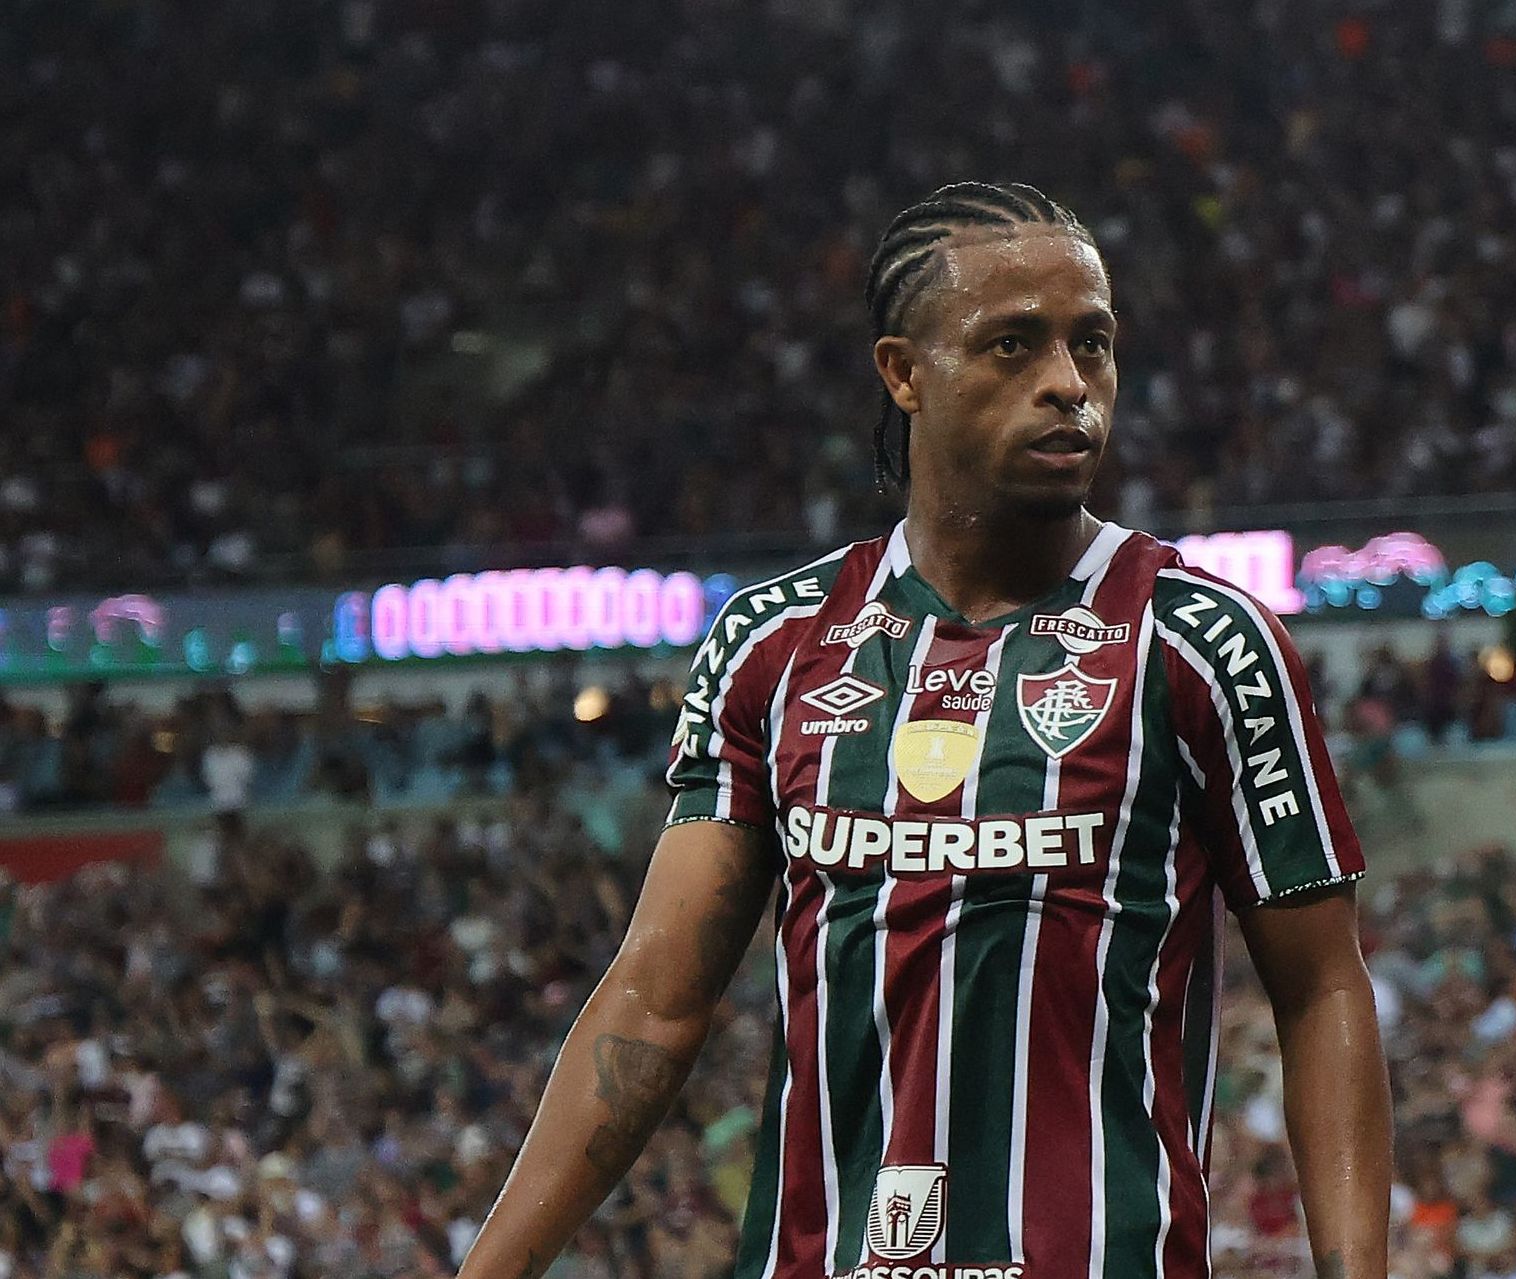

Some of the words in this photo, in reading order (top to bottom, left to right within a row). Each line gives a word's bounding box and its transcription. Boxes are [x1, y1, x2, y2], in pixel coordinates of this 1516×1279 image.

[832, 615, 902, 641] FRESCATTO
[1037, 619, 1124, 641] FRESCATTO
[906, 665, 996, 694] Leve
[942, 692, 991, 711] saúde
[1172, 592, 1300, 826] ZINZANE
[800, 716, 869, 736] umbro
[786, 806, 1104, 872] SUPERBET
